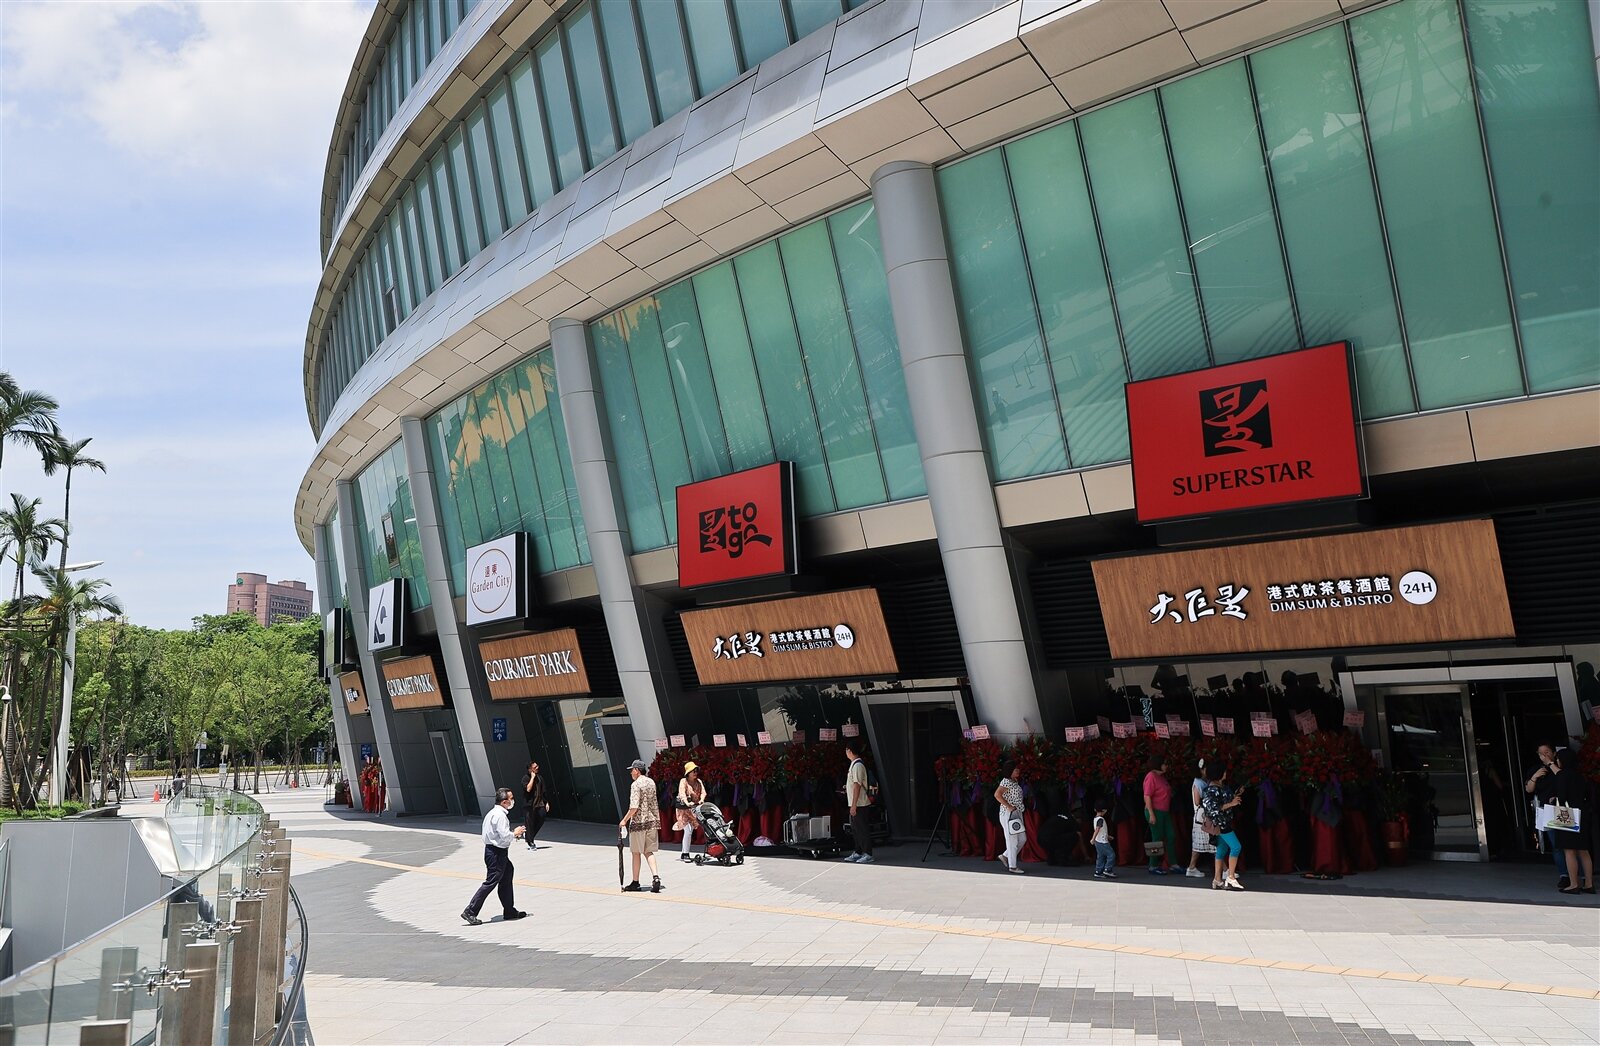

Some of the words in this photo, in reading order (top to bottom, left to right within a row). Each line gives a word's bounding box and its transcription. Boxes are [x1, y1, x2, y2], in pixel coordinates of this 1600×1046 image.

[1173, 460, 1314, 496] SUPERSTAR
[728, 502, 757, 530] to
[728, 524, 772, 558] go
[472, 580, 494, 593] Garden
[495, 575, 510, 588] City
[1267, 577, 1391, 600] 港式飲茶餐酒館
[1403, 582, 1433, 594] 24H
[1330, 597, 1342, 608] &
[1345, 594, 1393, 607] BISTRO
[769, 628, 831, 644] 港式飲茶餐酒館
[809, 640, 833, 650] BISTRO
[837, 632, 852, 641] 24H
[485, 655, 539, 681] GOURMET
[539, 651, 577, 676] PARK
[387, 676, 416, 697] GOURMET
[413, 673, 435, 693] PARK
